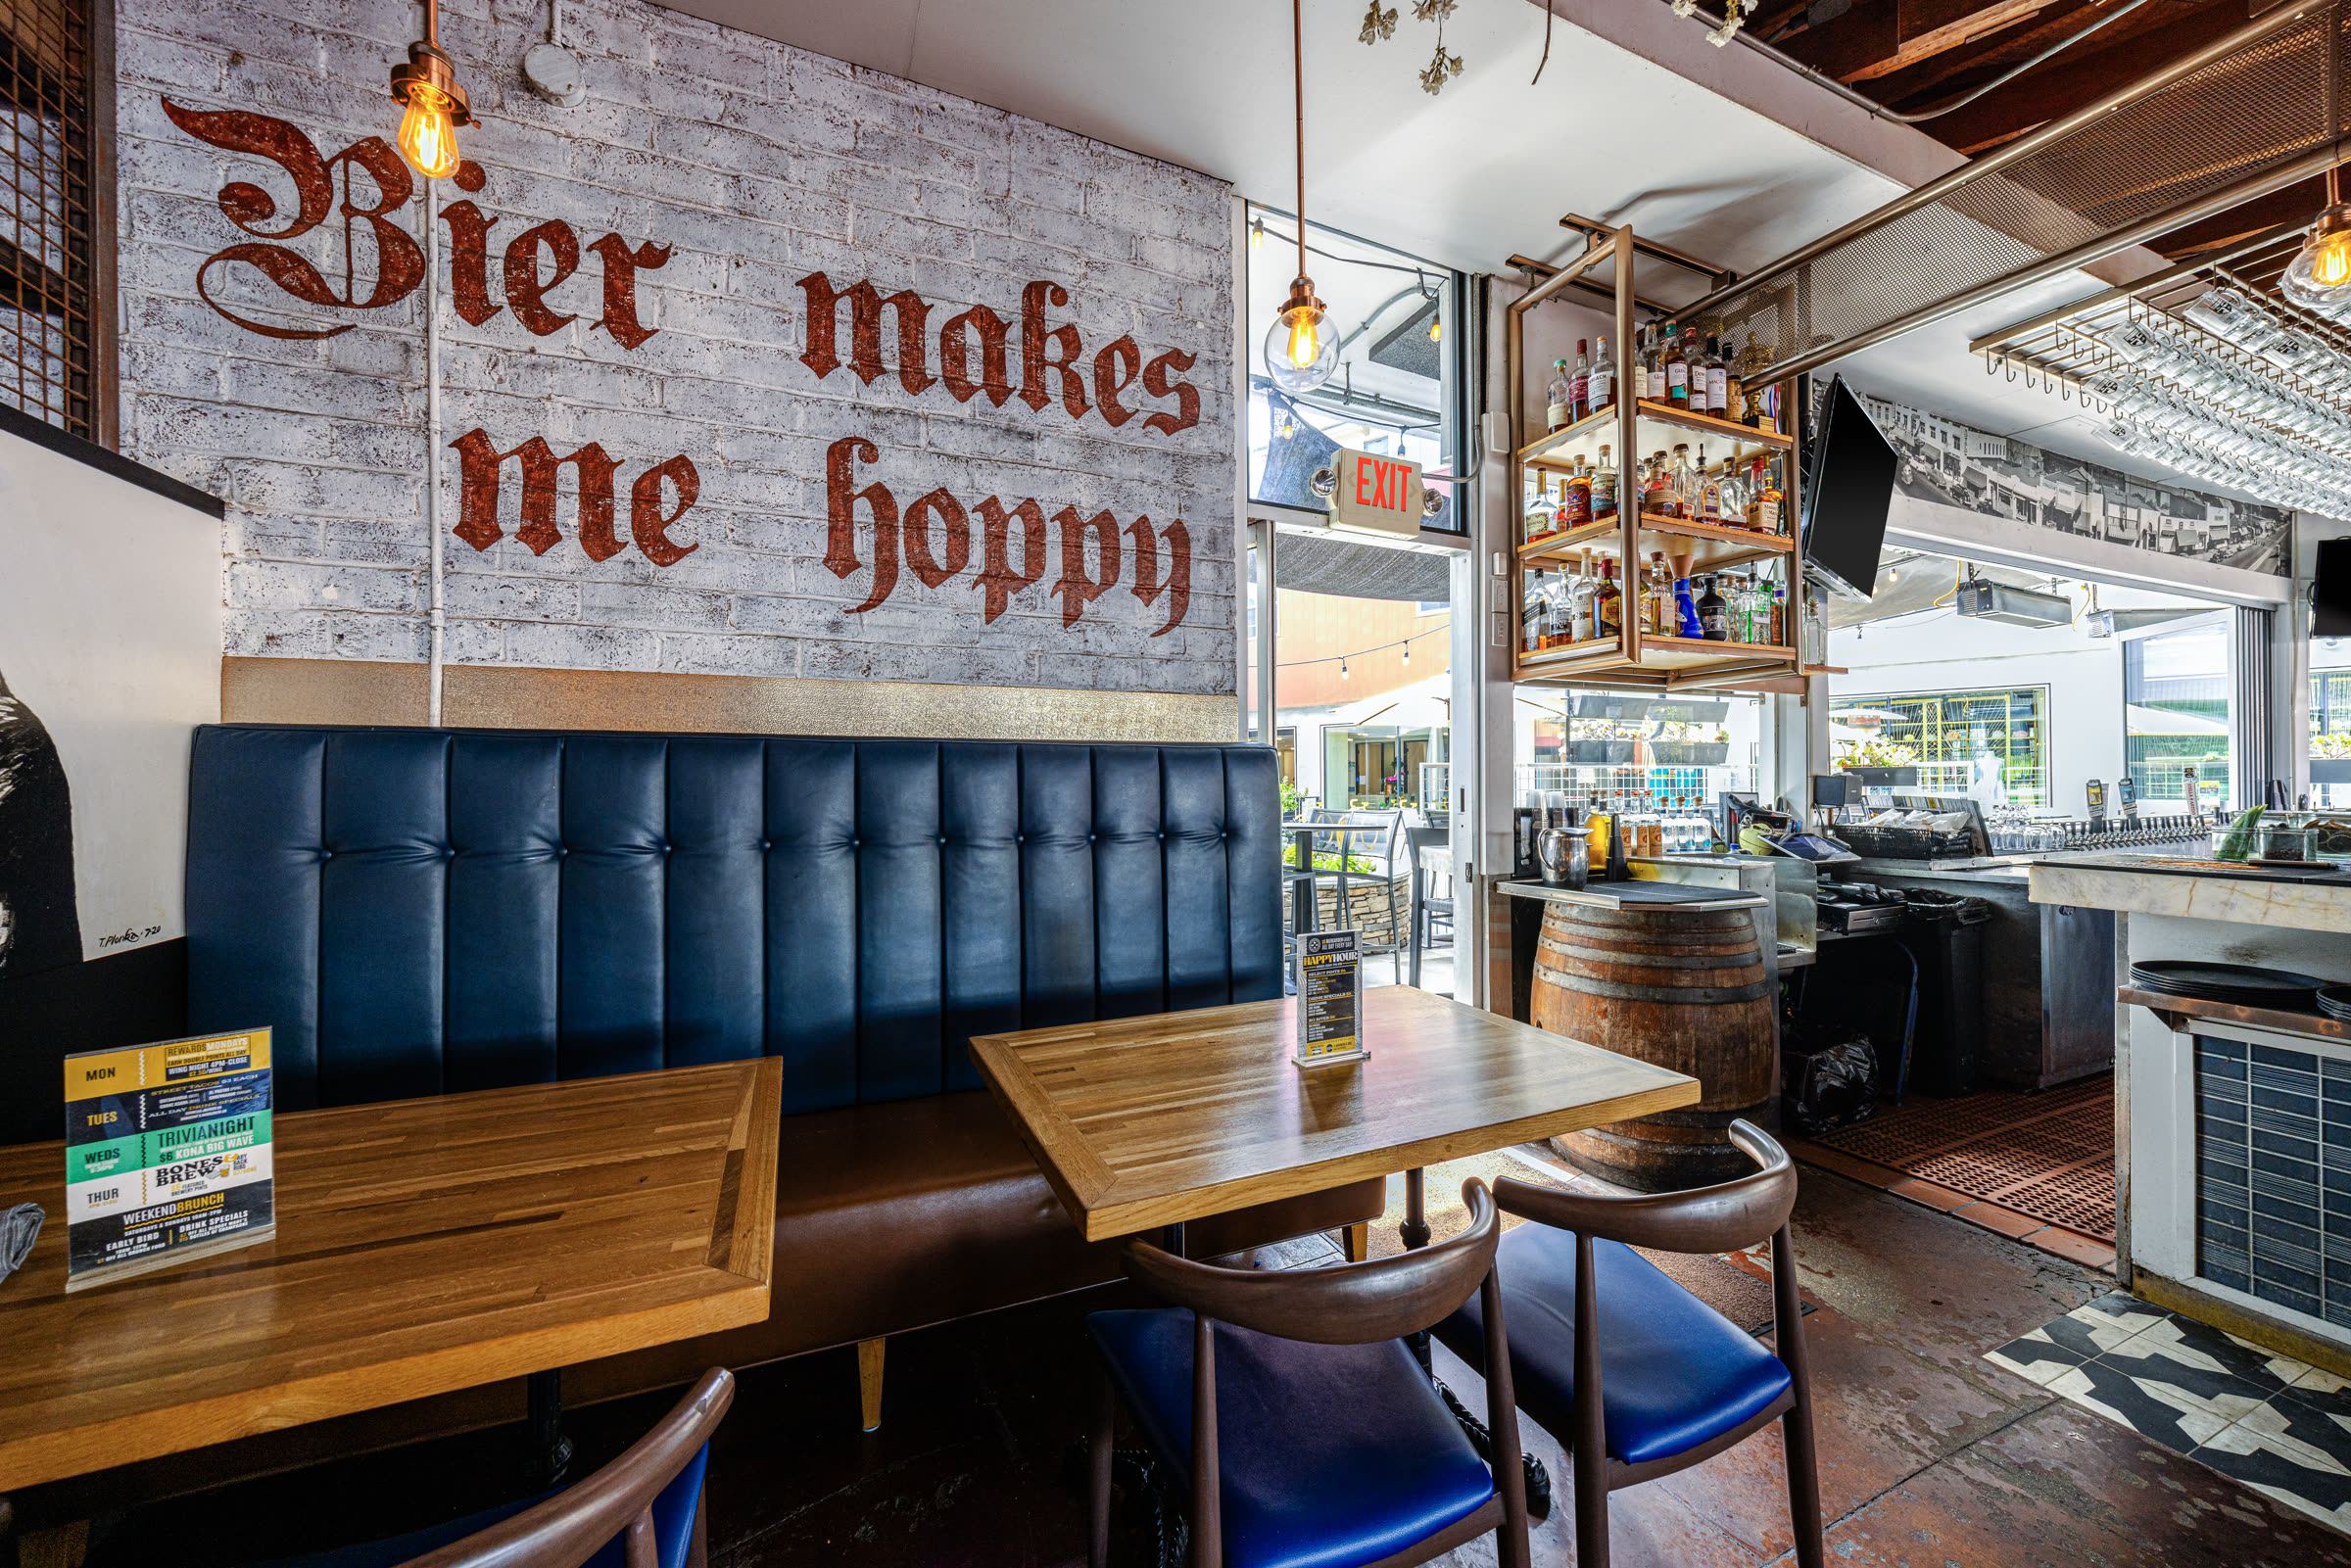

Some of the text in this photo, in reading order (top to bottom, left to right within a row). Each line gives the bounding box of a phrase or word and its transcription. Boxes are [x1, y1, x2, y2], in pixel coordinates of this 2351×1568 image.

[161, 95, 1199, 437] Bier makes
[1356, 456, 1413, 512] EXIT
[448, 427, 1191, 639] me hoppy
[86, 1068, 116, 1081] MON
[168, 1066, 187, 1074] WING
[188, 1062, 209, 1071] NIGHT
[86, 1111, 118, 1126] TUES
[84, 1147, 120, 1164] WEDS
[159, 1151, 173, 1164] $6
[174, 1144, 204, 1160] KONA
[206, 1140, 224, 1153] BIG
[226, 1134, 254, 1149] WAVE
[155, 1156, 222, 1178] BONES
[155, 1165, 216, 1187] BREW
[86, 1186, 119, 1205] THUR
[178, 1210, 248, 1233] DRINK SPECIALS
[106, 1230, 160, 1252] EARLY BIRD
